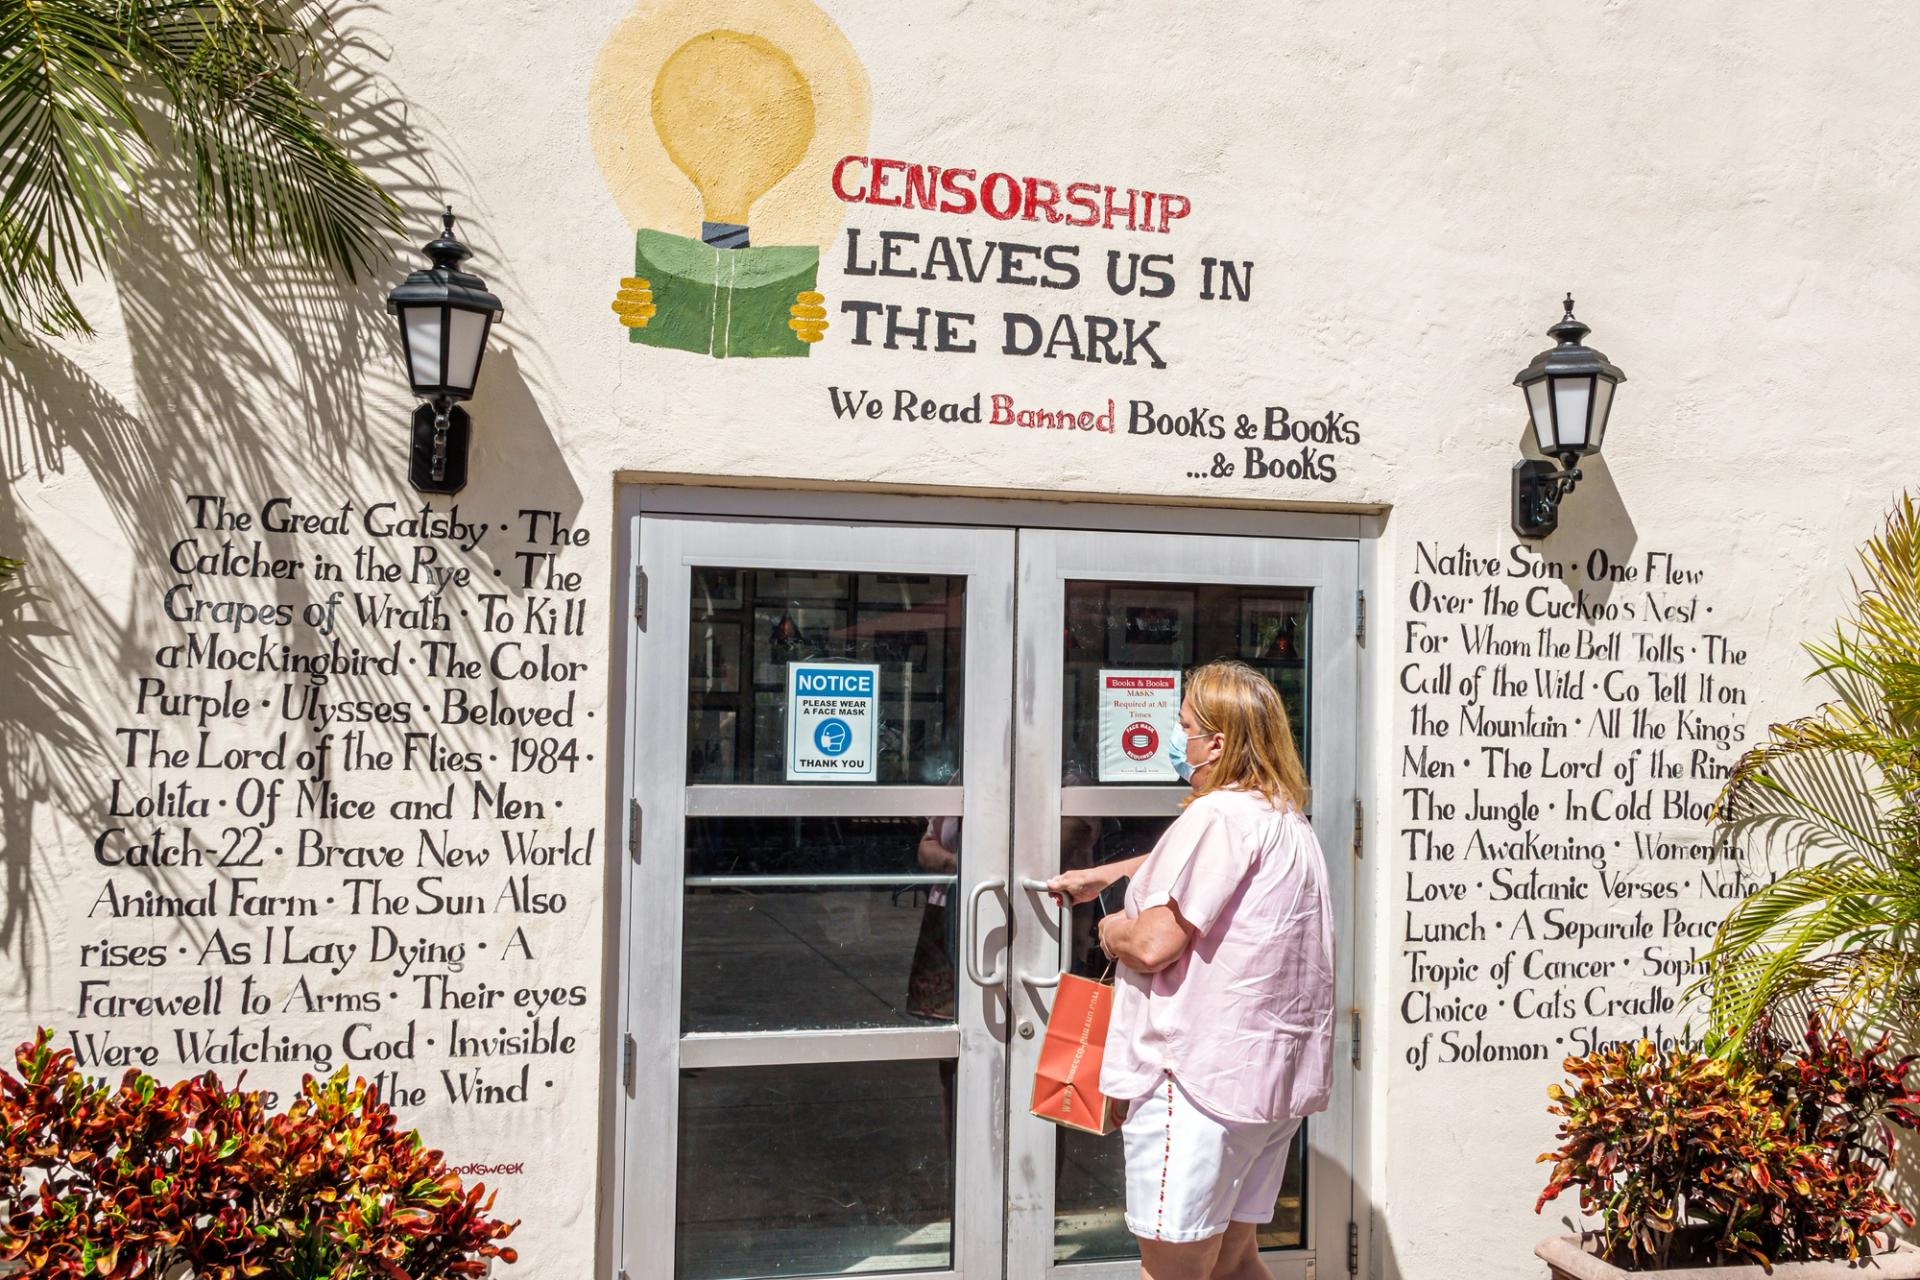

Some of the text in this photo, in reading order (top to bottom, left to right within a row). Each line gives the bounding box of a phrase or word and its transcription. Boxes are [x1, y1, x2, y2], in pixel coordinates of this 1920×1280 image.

[832, 155, 1191, 234] CENSORSHIP
[843, 228, 1254, 301] LEAVES US IN
[841, 300, 1167, 369] THE DARK
[828, 385, 1361, 446] We Read Banned Books & Books
[1243, 447, 1337, 483] Books
[186, 495, 591, 551] The Great Gatsby The
[170, 539, 582, 592] Catcher in the Rye The
[1414, 541, 1703, 585] Native Son One Flew
[164, 584, 586, 636] Grapes of Wrath To Kill
[1409, 579, 1473, 613] Over
[1483, 583, 1519, 617] the
[1643, 591, 1700, 622] Nest
[420, 641, 482, 680] The
[490, 643, 588, 682] Color
[1405, 620, 1747, 665] For Whom the Bell Tolls The
[136, 678, 573, 732] Purple Ulysses Beloved
[798, 675, 870, 692] NOTICE
[1113, 700, 1146, 709] Required
[1400, 662, 1452, 695] Call
[1459, 665, 1487, 706] of
[1492, 663, 1528, 697] the
[1534, 668, 1585, 700] Wild
[1604, 669, 1640, 702] Go
[1648, 672, 1687, 703] Tell
[1126, 724, 1140, 734] FACE
[1410, 702, 1745, 750] the Mountain All the King's
[116, 728, 579, 782] The Lord of the Flies 1984
[800, 759, 864, 768] THANK YOU
[1402, 745, 1455, 778] Men
[1481, 746, 1532, 779] The
[1540, 747, 1603, 779] Lord
[1614, 748, 1642, 786] of
[1650, 749, 1684, 779] the
[109, 778, 545, 828] Lolita Of Mice and Men
[1403, 787, 1456, 821] The
[1464, 788, 1540, 831] Jungle
[1565, 788, 1587, 821] In
[1591, 788, 1653, 821] Cold
[94, 827, 595, 869] Catch-22 Brave New World
[1401, 828, 1745, 870] The Awakening Women in
[88, 876, 566, 918] Animal Farm The Sun Also
[1406, 871, 1467, 901] Love
[1490, 867, 1588, 901] Satanic
[1599, 871, 1678, 899] Verses
[1405, 910, 1486, 942] Lunch
[1510, 909, 1536, 940] A
[1543, 908, 1653, 949] Separate
[80, 926, 534, 977] rises As I Lay Dying A
[1403, 950, 1479, 990] Tropic
[1490, 950, 1517, 990] of
[1523, 949, 1615, 980] Cancer
[78, 974, 587, 1018] Farewell to Arms Their eyes
[1401, 991, 1488, 1024] Choice
[1513, 985, 1577, 1019] Cat's
[1584, 985, 1675, 1017] Cradle
[69, 1016, 576, 1072] Were Watching God Invisible
[1406, 1032, 1434, 1071] of
[1438, 1030, 1549, 1063] Solomon
[373, 1069, 427, 1107] the
[440, 1064, 529, 1104] Wind
